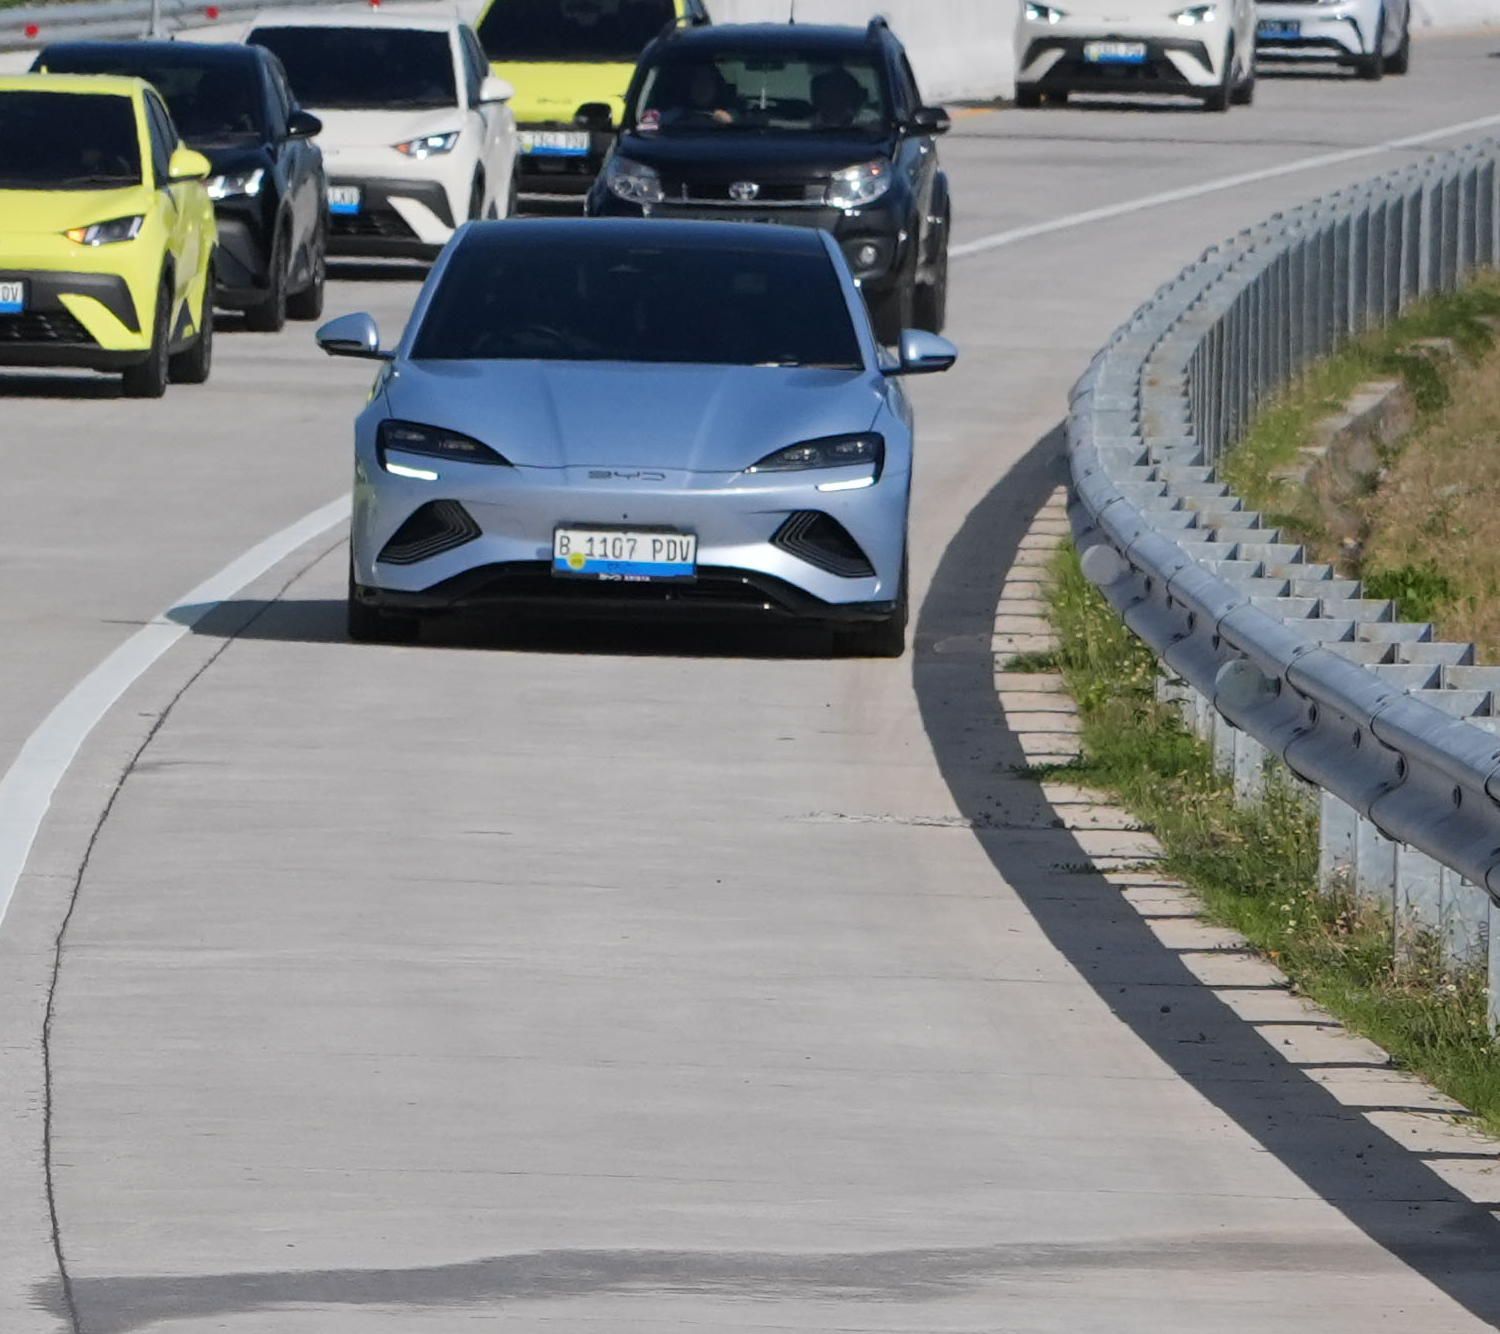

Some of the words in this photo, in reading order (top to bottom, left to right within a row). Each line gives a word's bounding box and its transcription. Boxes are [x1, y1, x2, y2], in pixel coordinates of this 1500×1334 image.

[587, 470, 666, 482] BYD
[559, 535, 571, 556] B
[585, 537, 637, 560] 1107
[652, 539, 691, 562] PDV
